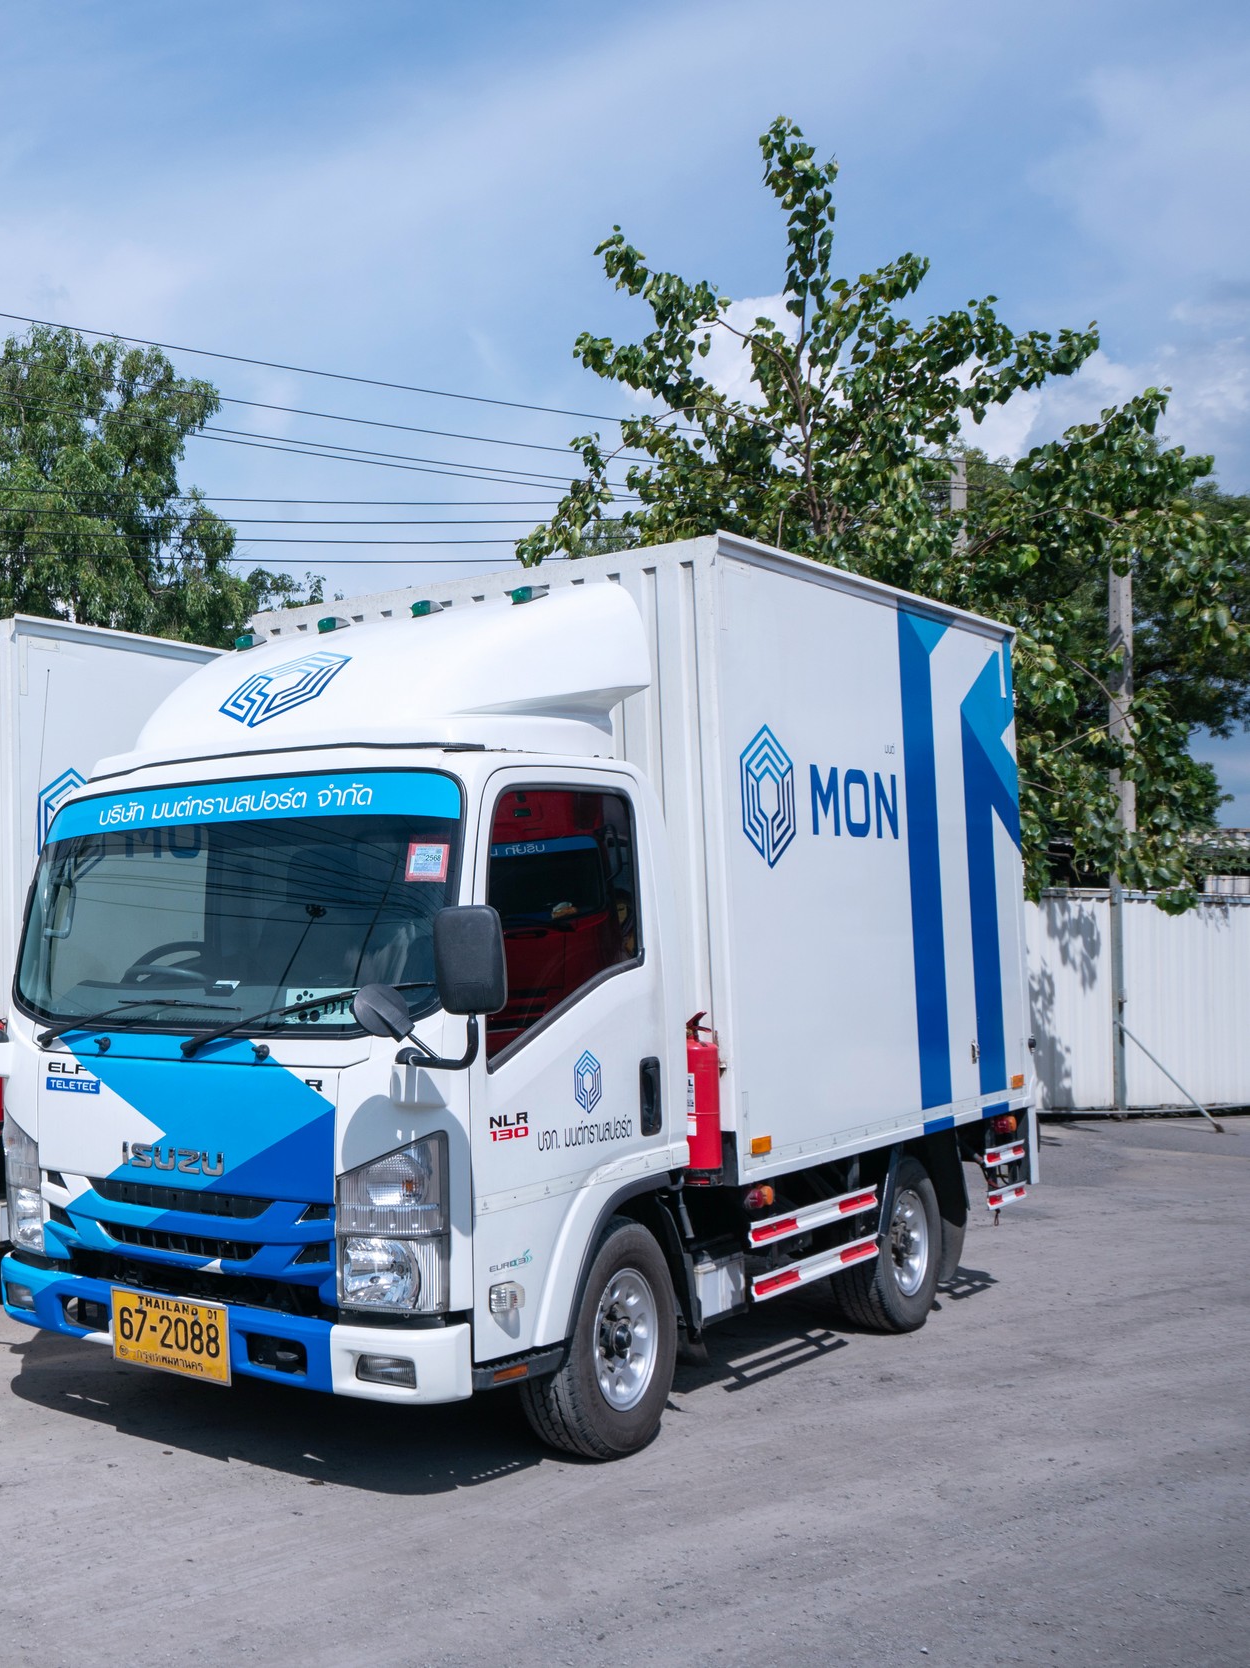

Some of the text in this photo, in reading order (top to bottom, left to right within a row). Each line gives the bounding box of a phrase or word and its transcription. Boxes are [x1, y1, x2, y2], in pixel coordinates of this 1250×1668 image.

[99, 783, 373, 826] บริษัท มนต์ทรานสปอร์ต จำกัด
[810, 763, 899, 840] MON
[48, 1061, 88, 1075] ELF
[50, 1078, 98, 1093] TELETEC
[489, 1111, 529, 1129] NLR
[490, 1126, 529, 1142] 130
[537, 1114, 633, 1152] บจก. มนต์ทรานสปอร์ต
[122, 1141, 224, 1177] ISUZU
[137, 1295, 199, 1316] THAILAND
[119, 1306, 221, 1359] 67-2088
